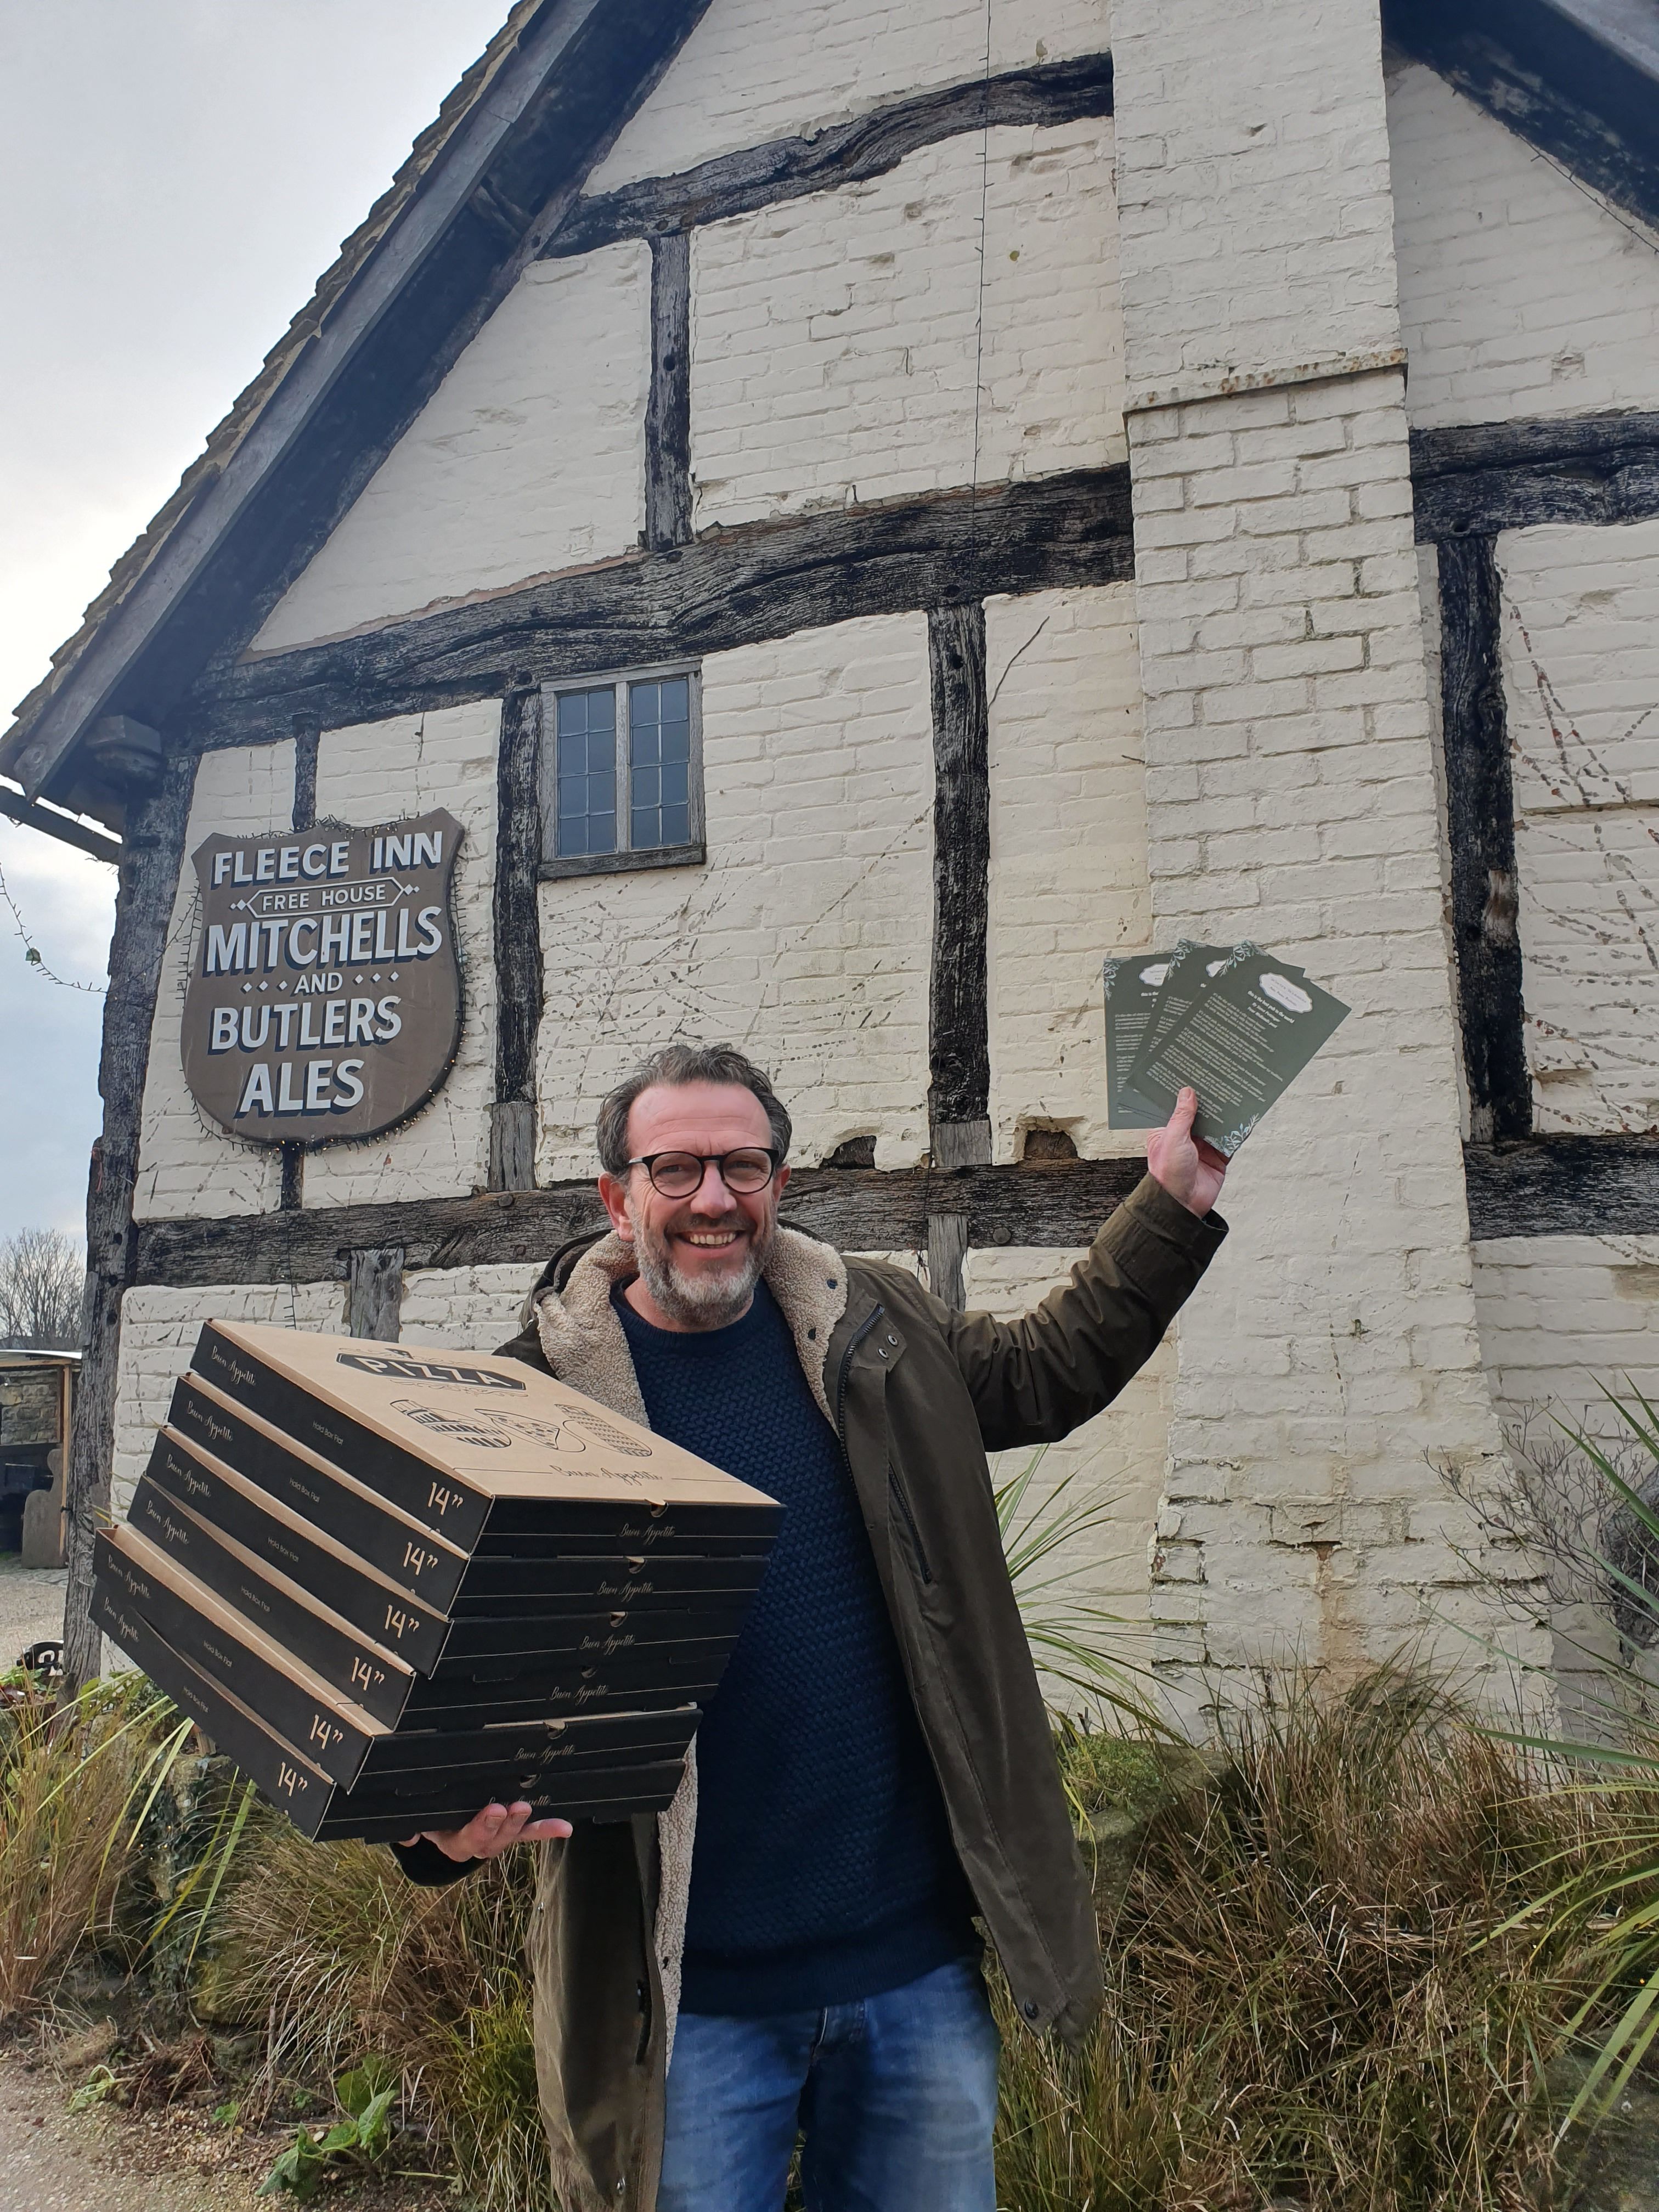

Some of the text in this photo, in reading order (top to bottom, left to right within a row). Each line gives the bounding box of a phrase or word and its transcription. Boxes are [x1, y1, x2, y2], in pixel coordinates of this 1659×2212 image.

[214, 831, 442, 884] FLEECE INN
[262, 884, 386, 911] FREE HOUSE
[207, 906, 442, 972] MITCHELLS
[294, 972, 343, 994] AND
[212, 996, 402, 1050] BUTLERS
[240, 1059, 365, 1112] ALES
[355, 1357, 513, 1386] PIZZA
[312, 1420, 343, 1446] Hold Box Flat
[289, 1477, 320, 1504] Hold Box Flat
[268, 1537, 299, 1563] Hold Box Flat
[241, 1585, 270, 1612] Hold Box Flat
